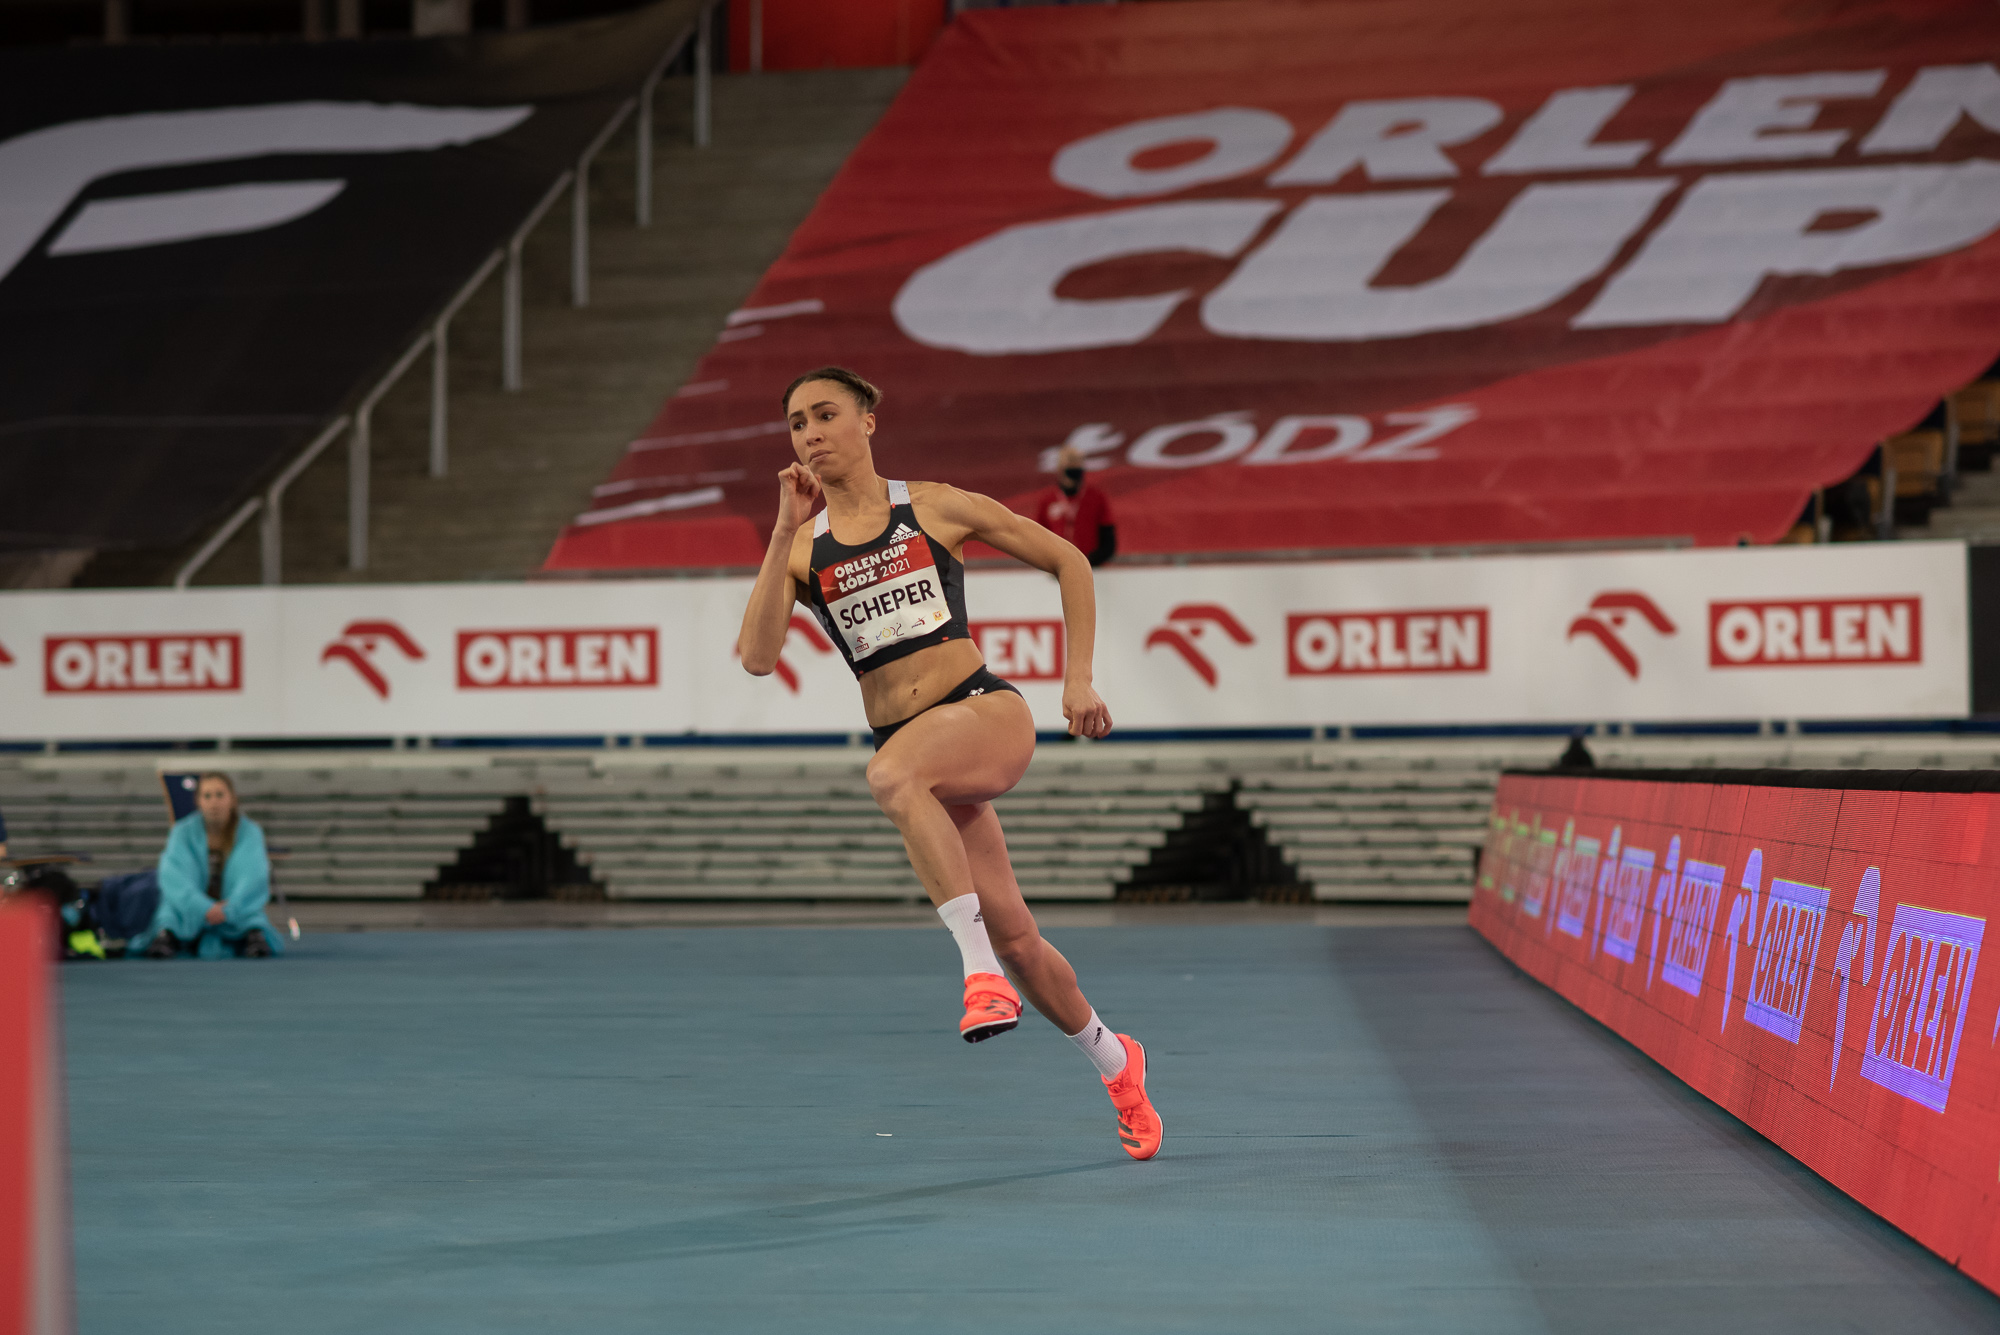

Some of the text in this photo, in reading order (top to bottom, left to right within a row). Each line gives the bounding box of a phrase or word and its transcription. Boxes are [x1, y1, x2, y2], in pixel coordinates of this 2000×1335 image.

[892, 160, 2000, 355] CUP
[834, 543, 909, 579] ORLEN CUP
[889, 530, 919, 545] adidas
[838, 557, 911, 593] ŁÓDŹ 2021
[839, 579, 937, 630] SCHEPER
[1293, 617, 1481, 670] ORLEN
[1714, 604, 1914, 662] ORLEN
[50, 641, 234, 688] ORLEN
[462, 634, 651, 684] ORLEN
[1754, 900, 1823, 1020] ORLEN
[1873, 930, 1973, 1083] ORLEN
